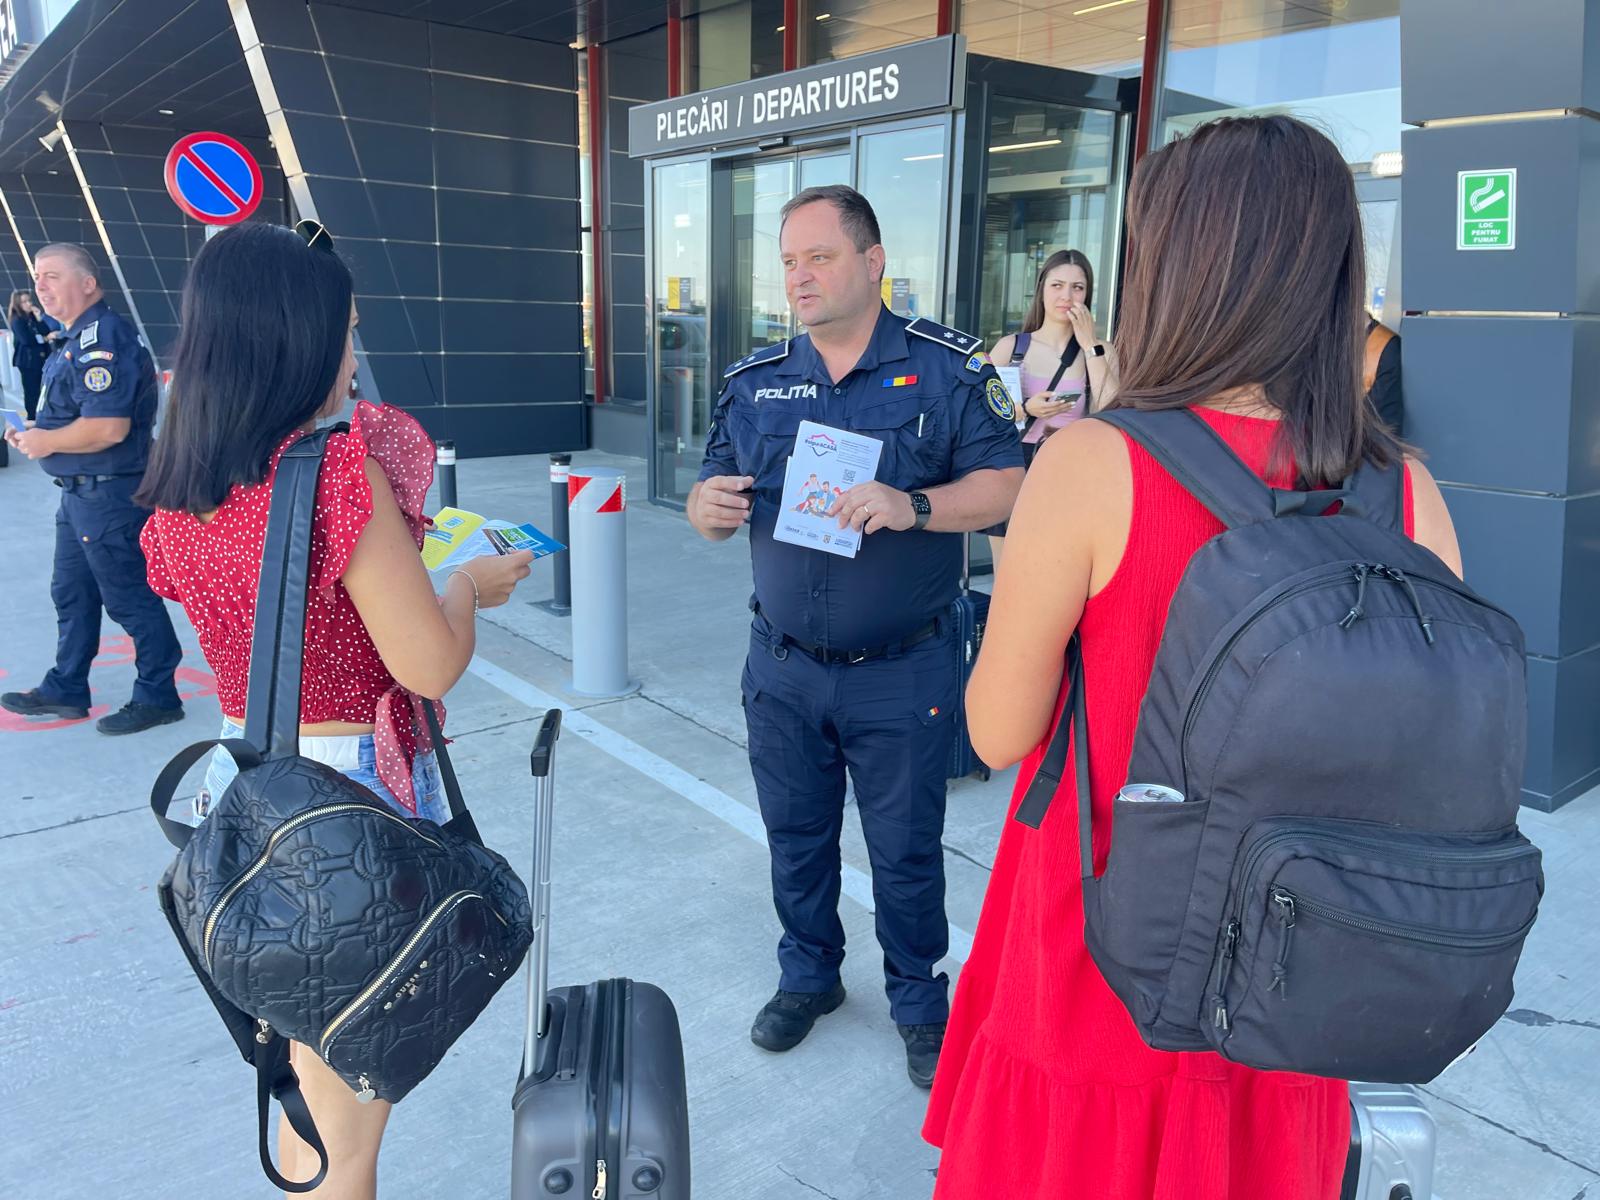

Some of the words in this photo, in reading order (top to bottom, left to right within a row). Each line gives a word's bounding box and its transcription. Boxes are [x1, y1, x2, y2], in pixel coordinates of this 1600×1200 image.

[657, 96, 728, 142] PLECĂRI
[736, 96, 744, 127] /
[753, 63, 899, 124] DEPARTURES
[754, 384, 817, 402] POLITIA
